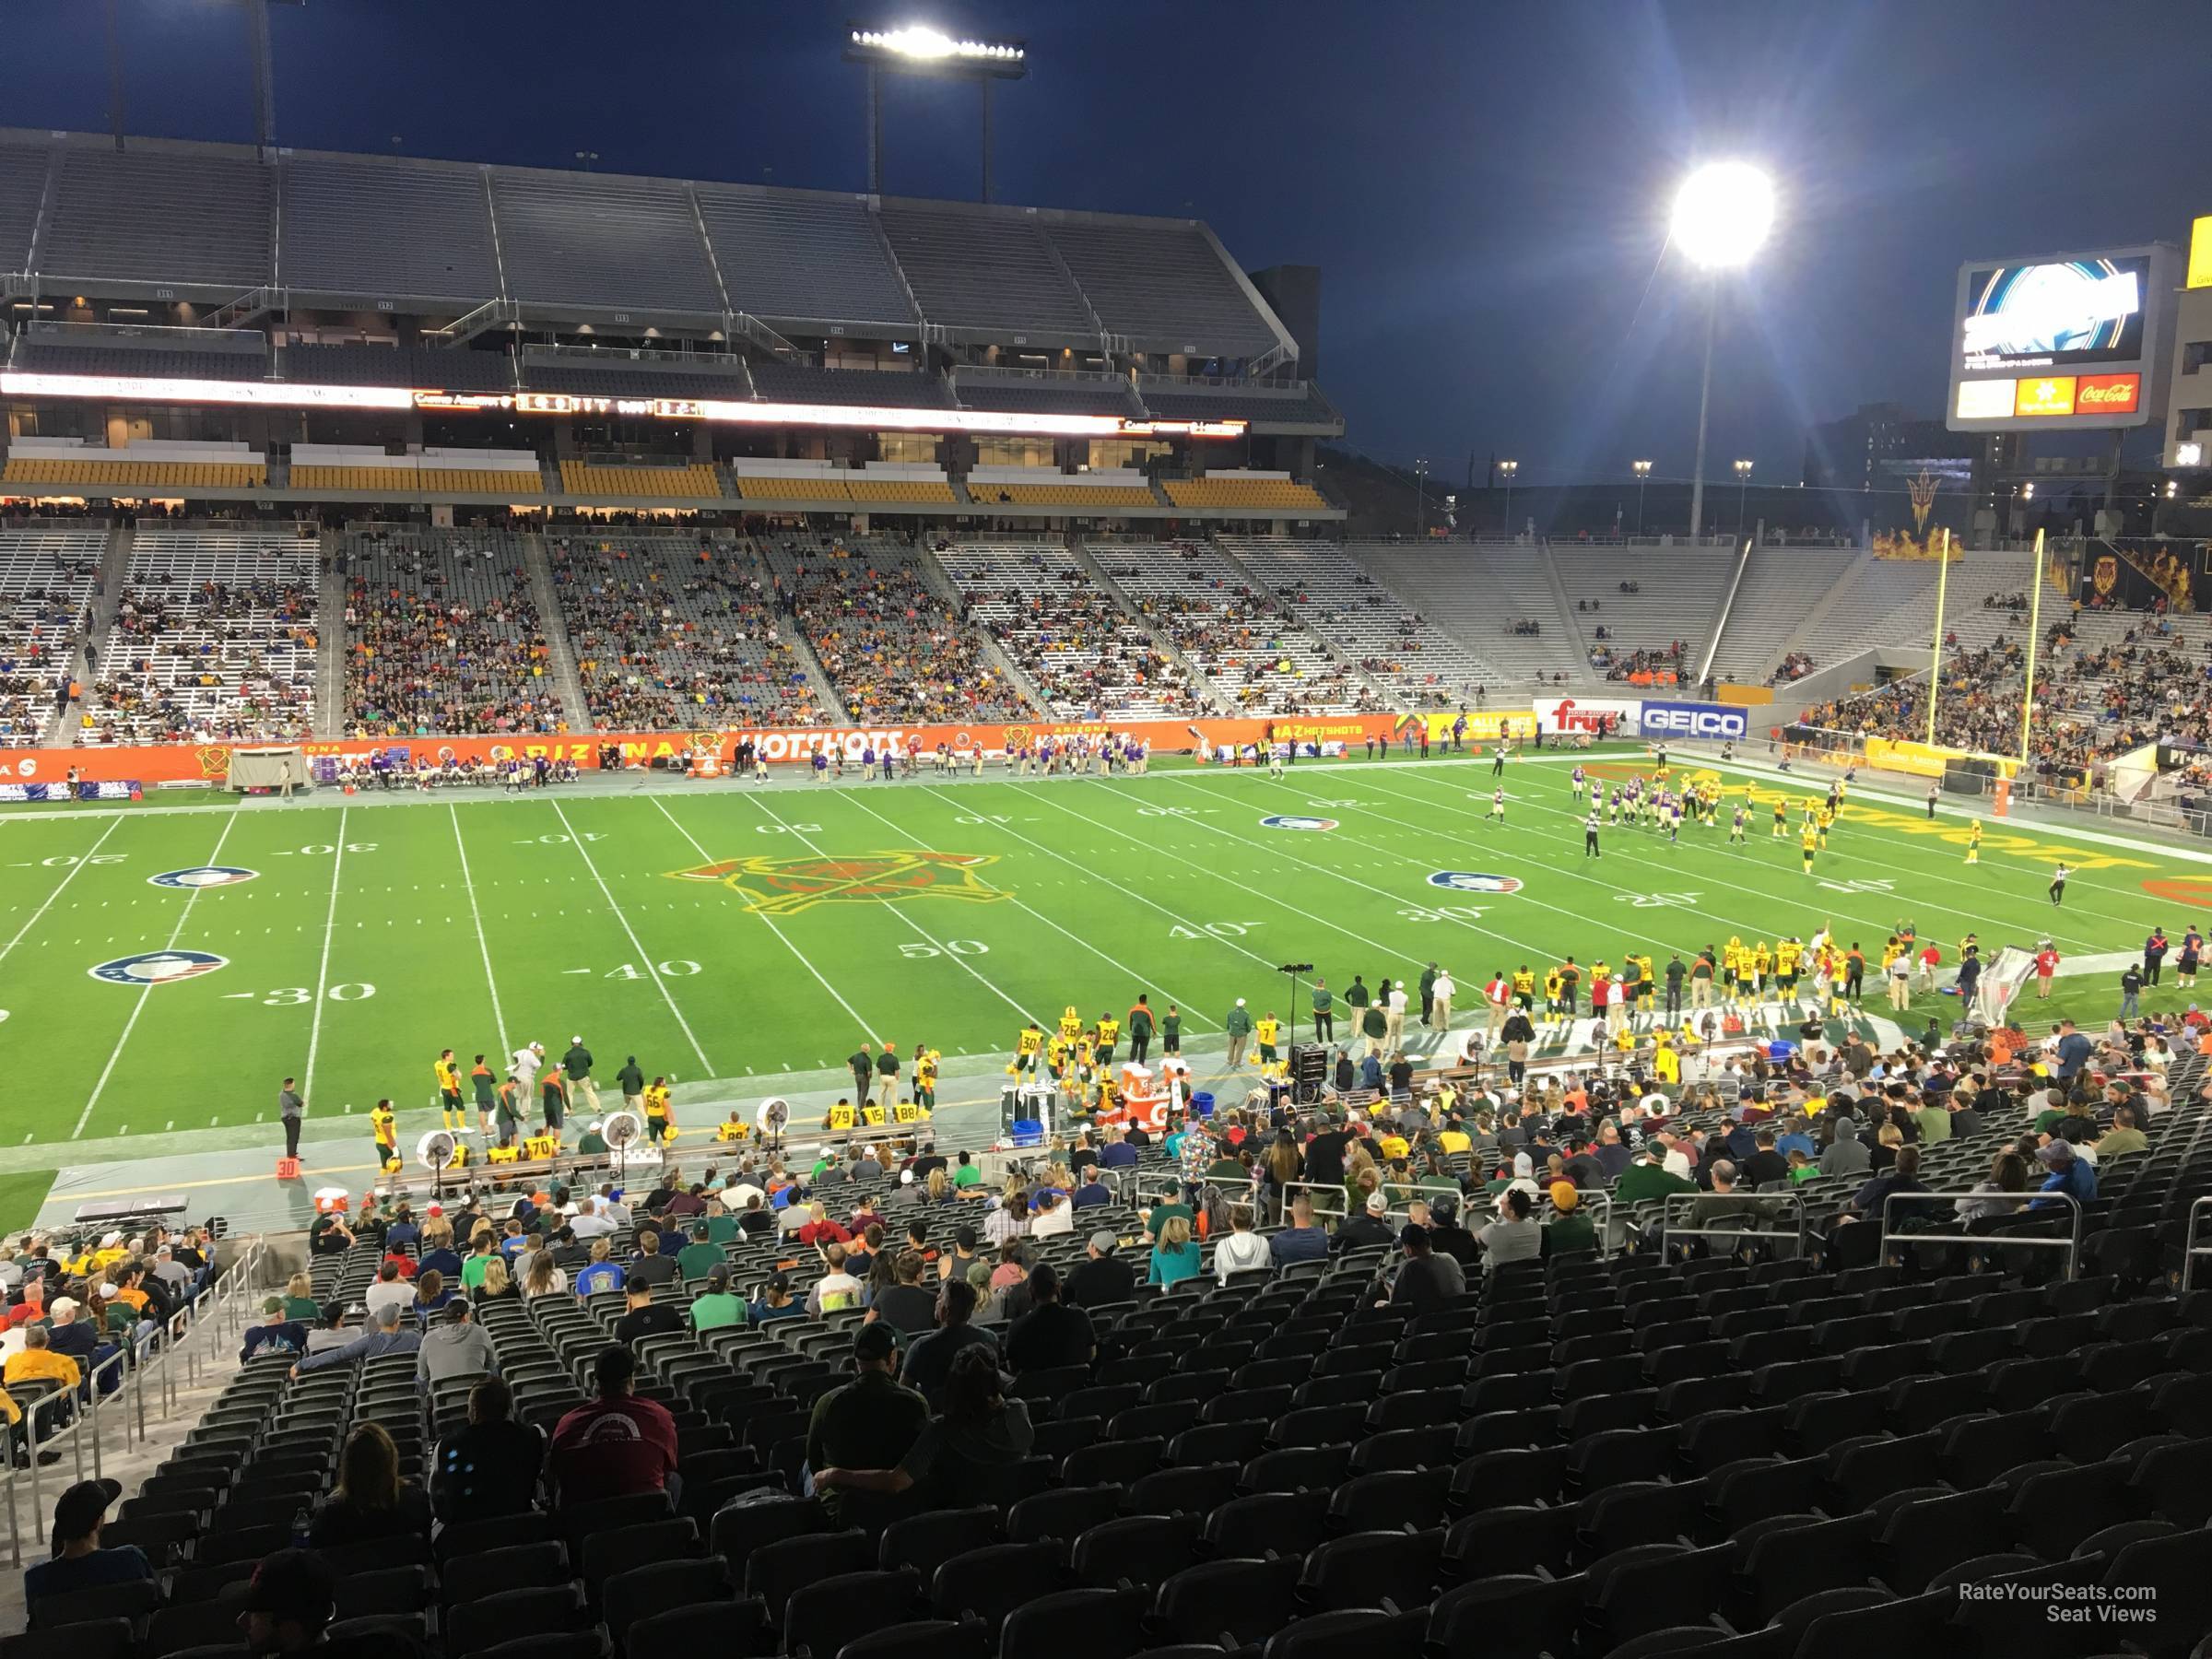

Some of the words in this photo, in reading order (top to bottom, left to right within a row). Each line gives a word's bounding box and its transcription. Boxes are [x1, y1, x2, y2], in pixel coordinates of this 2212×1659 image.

[2197, 275, 2212, 285] GIV
[1644, 709, 1745, 735] GEICO
[504, 742, 675, 760] ARIZNA
[1170, 922, 1249, 940] 40
[898, 938, 991, 959] 50
[604, 959, 702, 982] 40
[262, 982, 377, 1006] 30
[1064, 1024, 1077, 1038] 26
[1103, 1029, 1115, 1041] 20
[1264, 1028, 1271, 1041] 7
[1023, 1036, 1037, 1051] 30
[647, 1094, 660, 1109] 66
[834, 1111, 850, 1124] 79
[870, 1109, 883, 1122] 15
[900, 1107, 914, 1120] 88
[533, 1140, 550, 1157] 70
[277, 1160, 295, 1177] 30
